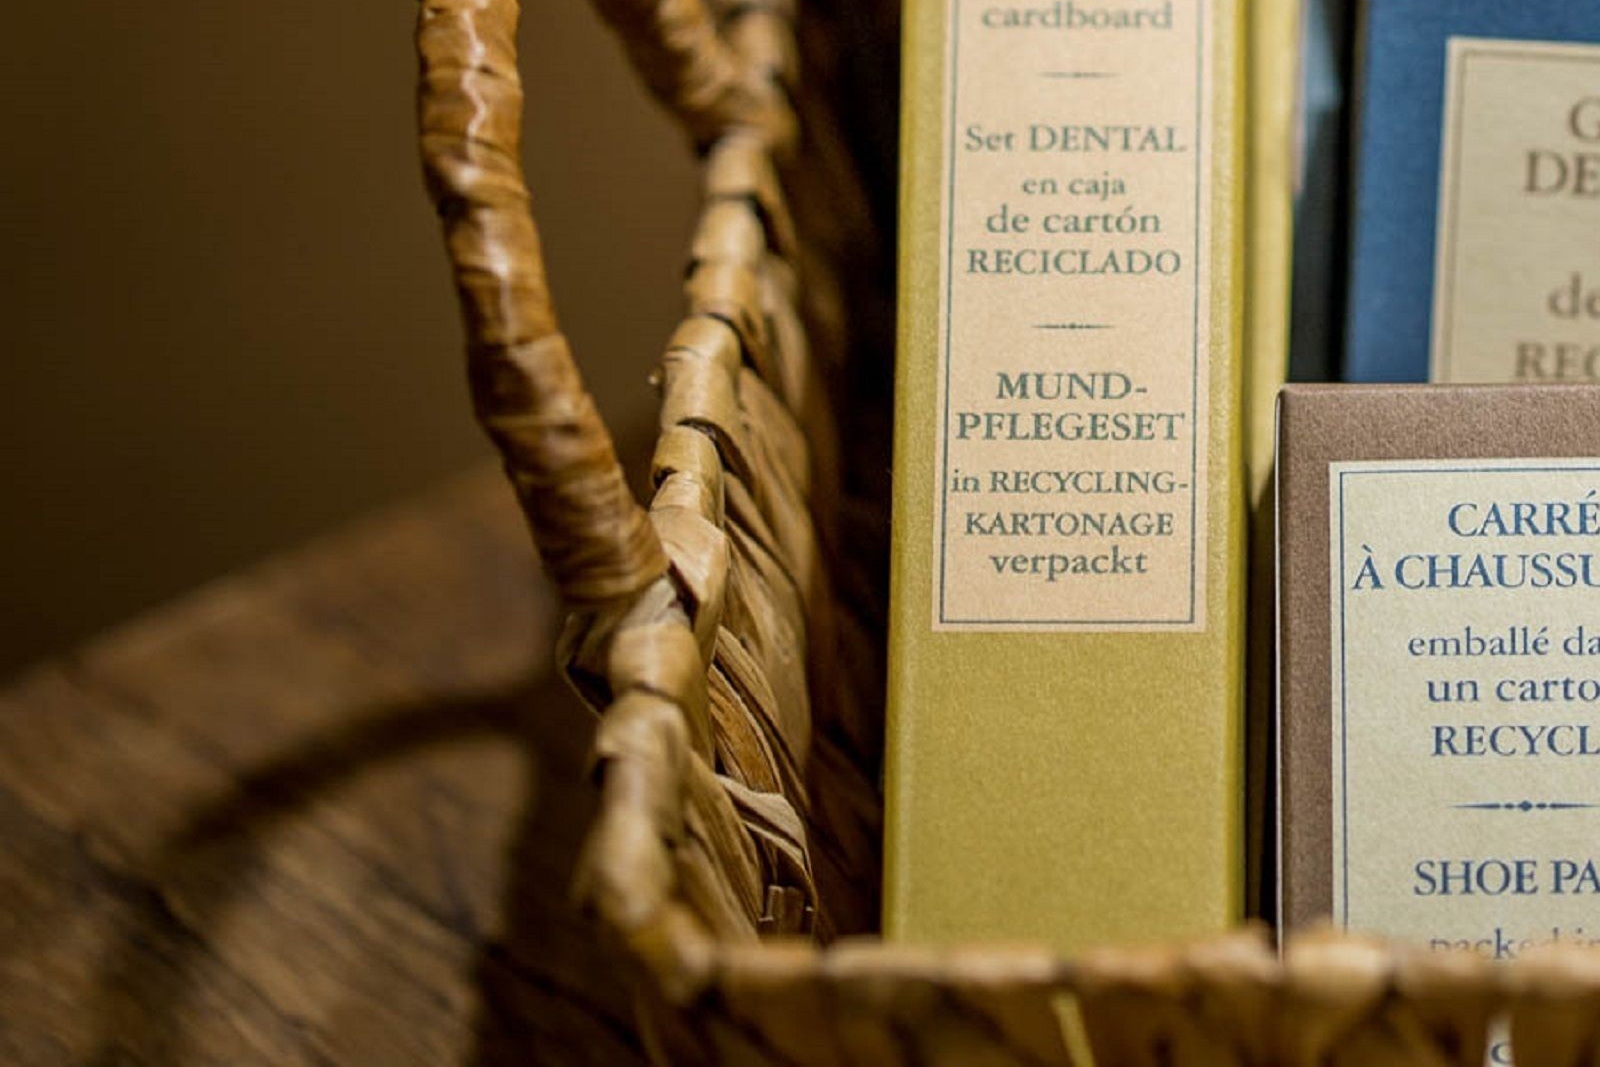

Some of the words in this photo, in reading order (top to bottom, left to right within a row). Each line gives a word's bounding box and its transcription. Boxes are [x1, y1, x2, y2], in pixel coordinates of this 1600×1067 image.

[981, 0, 1173, 30] cardboard
[965, 123, 1015, 152] Set
[1029, 124, 1187, 153] DENTAL
[1022, 177, 1058, 195] en
[1068, 170, 1126, 201] caja
[986, 203, 1030, 233] de
[1042, 204, 1161, 234] cartón
[966, 248, 1181, 275] RECICLADO
[995, 371, 1148, 400] MUND-
[955, 412, 1185, 441] PFLEGESET
[951, 469, 980, 493] in
[990, 470, 1188, 494] RECYCLING-
[964, 512, 1175, 536] KARTONAGE
[990, 545, 1149, 582] verpackt
[1352, 544, 1384, 590] À
[1407, 626, 1550, 657] emballé
[1426, 680, 1480, 702] un
[1413, 859, 1539, 896] SHOE
